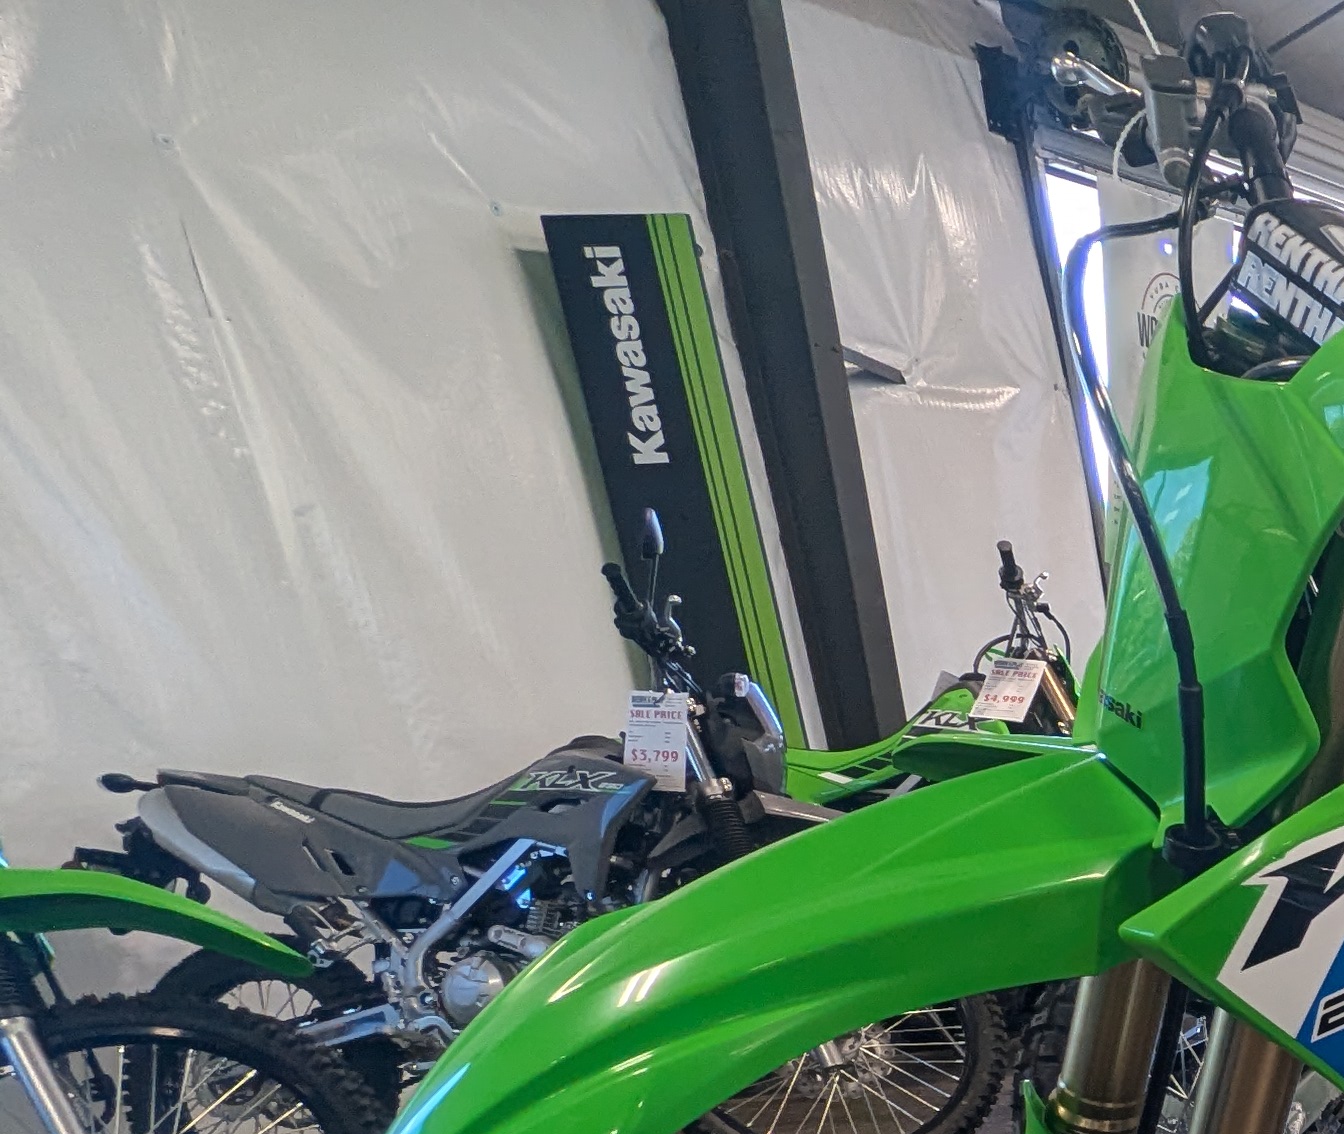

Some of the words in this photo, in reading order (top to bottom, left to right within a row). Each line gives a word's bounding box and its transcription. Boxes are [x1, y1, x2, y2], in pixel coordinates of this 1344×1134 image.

[583, 245, 670, 464] Kawasaki
[984, 693, 1025, 704] $4,999
[654, 710, 682, 720] PRICE
[631, 748, 679, 763] $3,799
